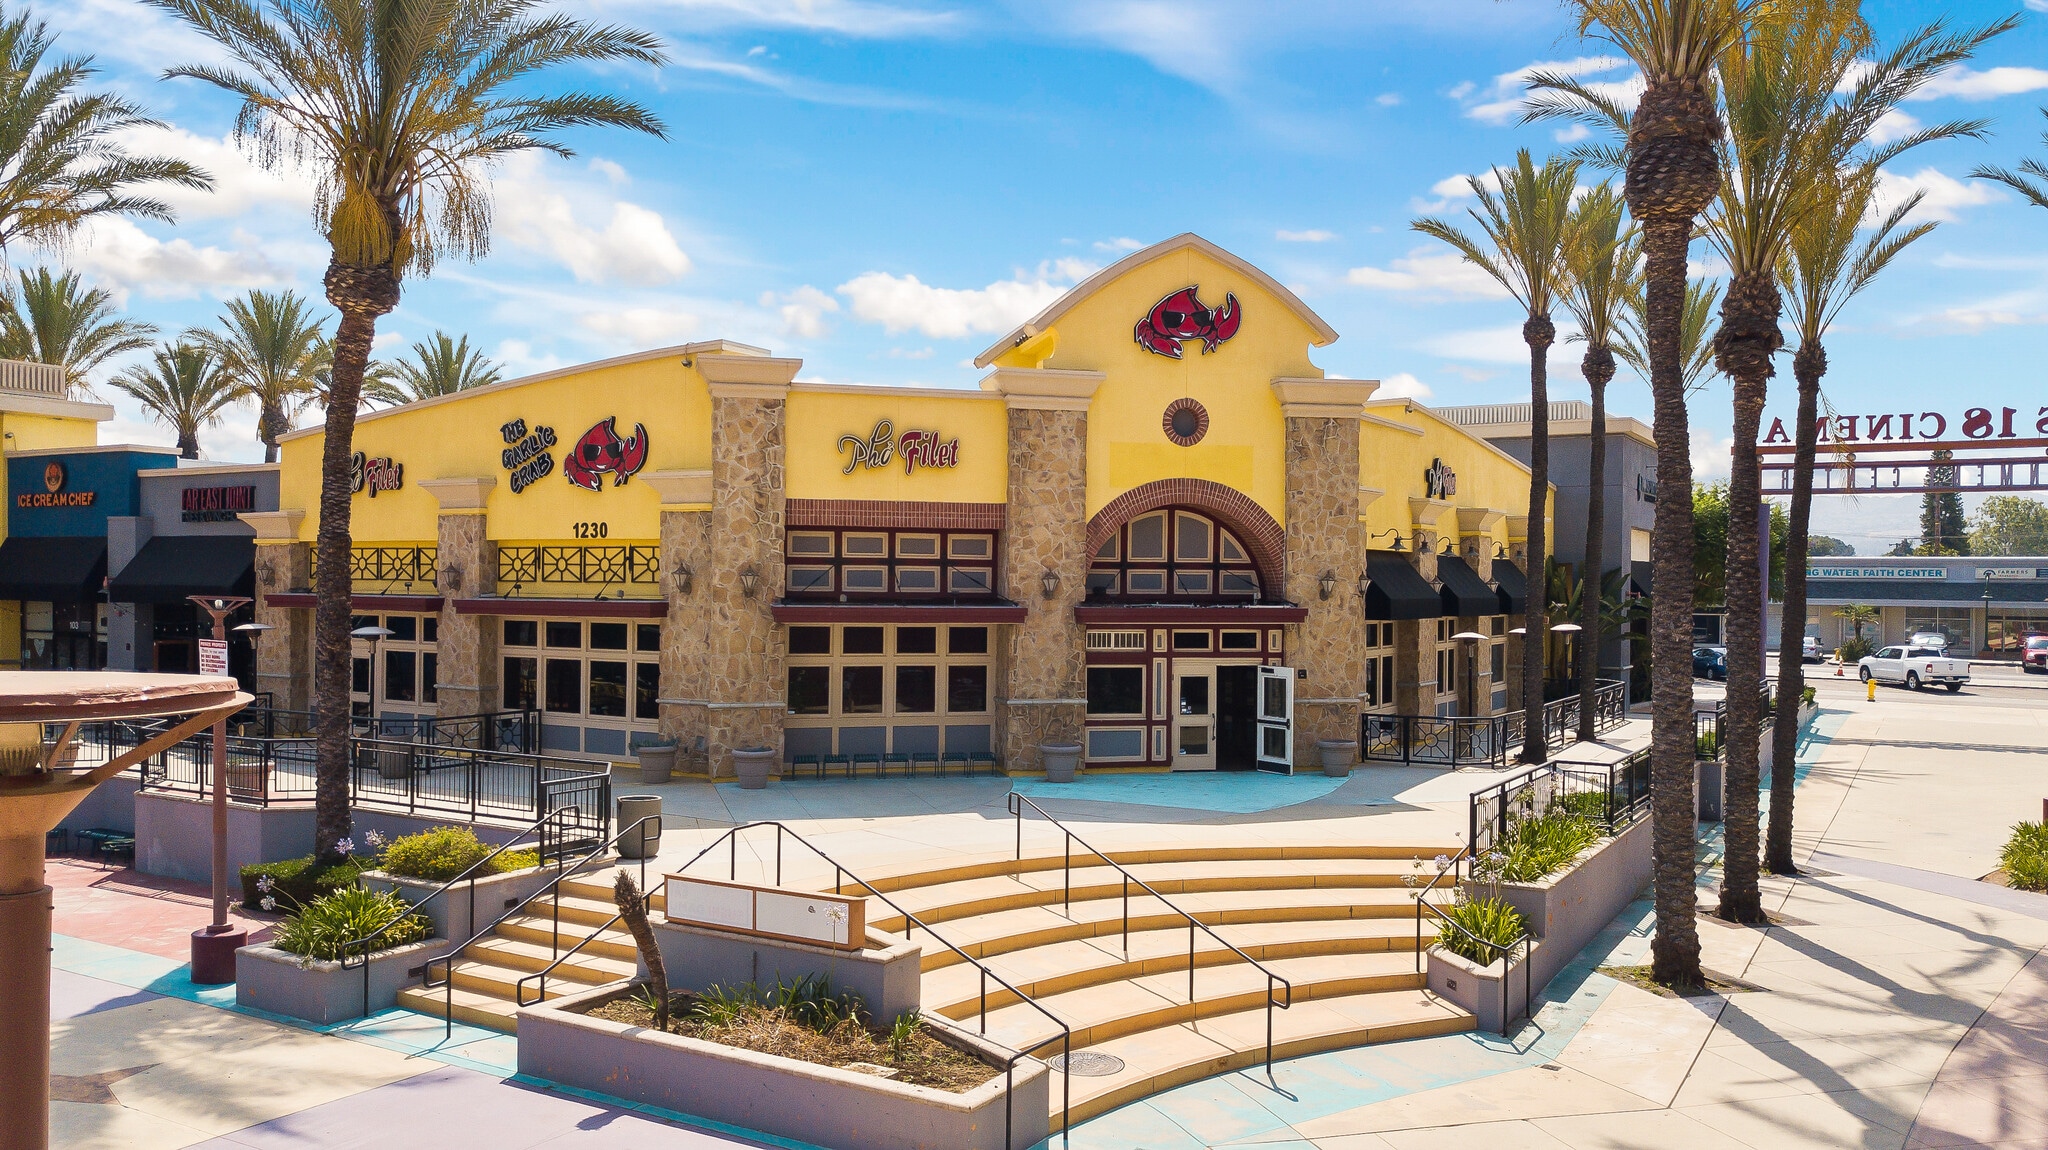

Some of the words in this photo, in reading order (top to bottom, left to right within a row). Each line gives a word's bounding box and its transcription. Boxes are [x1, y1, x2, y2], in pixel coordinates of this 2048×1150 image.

[500, 418, 528, 443] THE
[898, 429, 960, 476] Filet
[364, 457, 403, 498] Filet
[510, 452, 555, 494] CRAB
[17, 494, 32, 508] ICE
[33, 493, 67, 507] CREAM
[68, 491, 94, 507] CHEF
[182, 488, 198, 510] FAR
[201, 487, 223, 510] EAST
[226, 486, 252, 510] JOINT
[572, 522, 608, 538] 1230
[1822, 568, 1860, 577] WATER
[1863, 569, 1894, 577] FAITH
[1897, 569, 1943, 577] CENTER
[69, 621, 79, 630] 103
